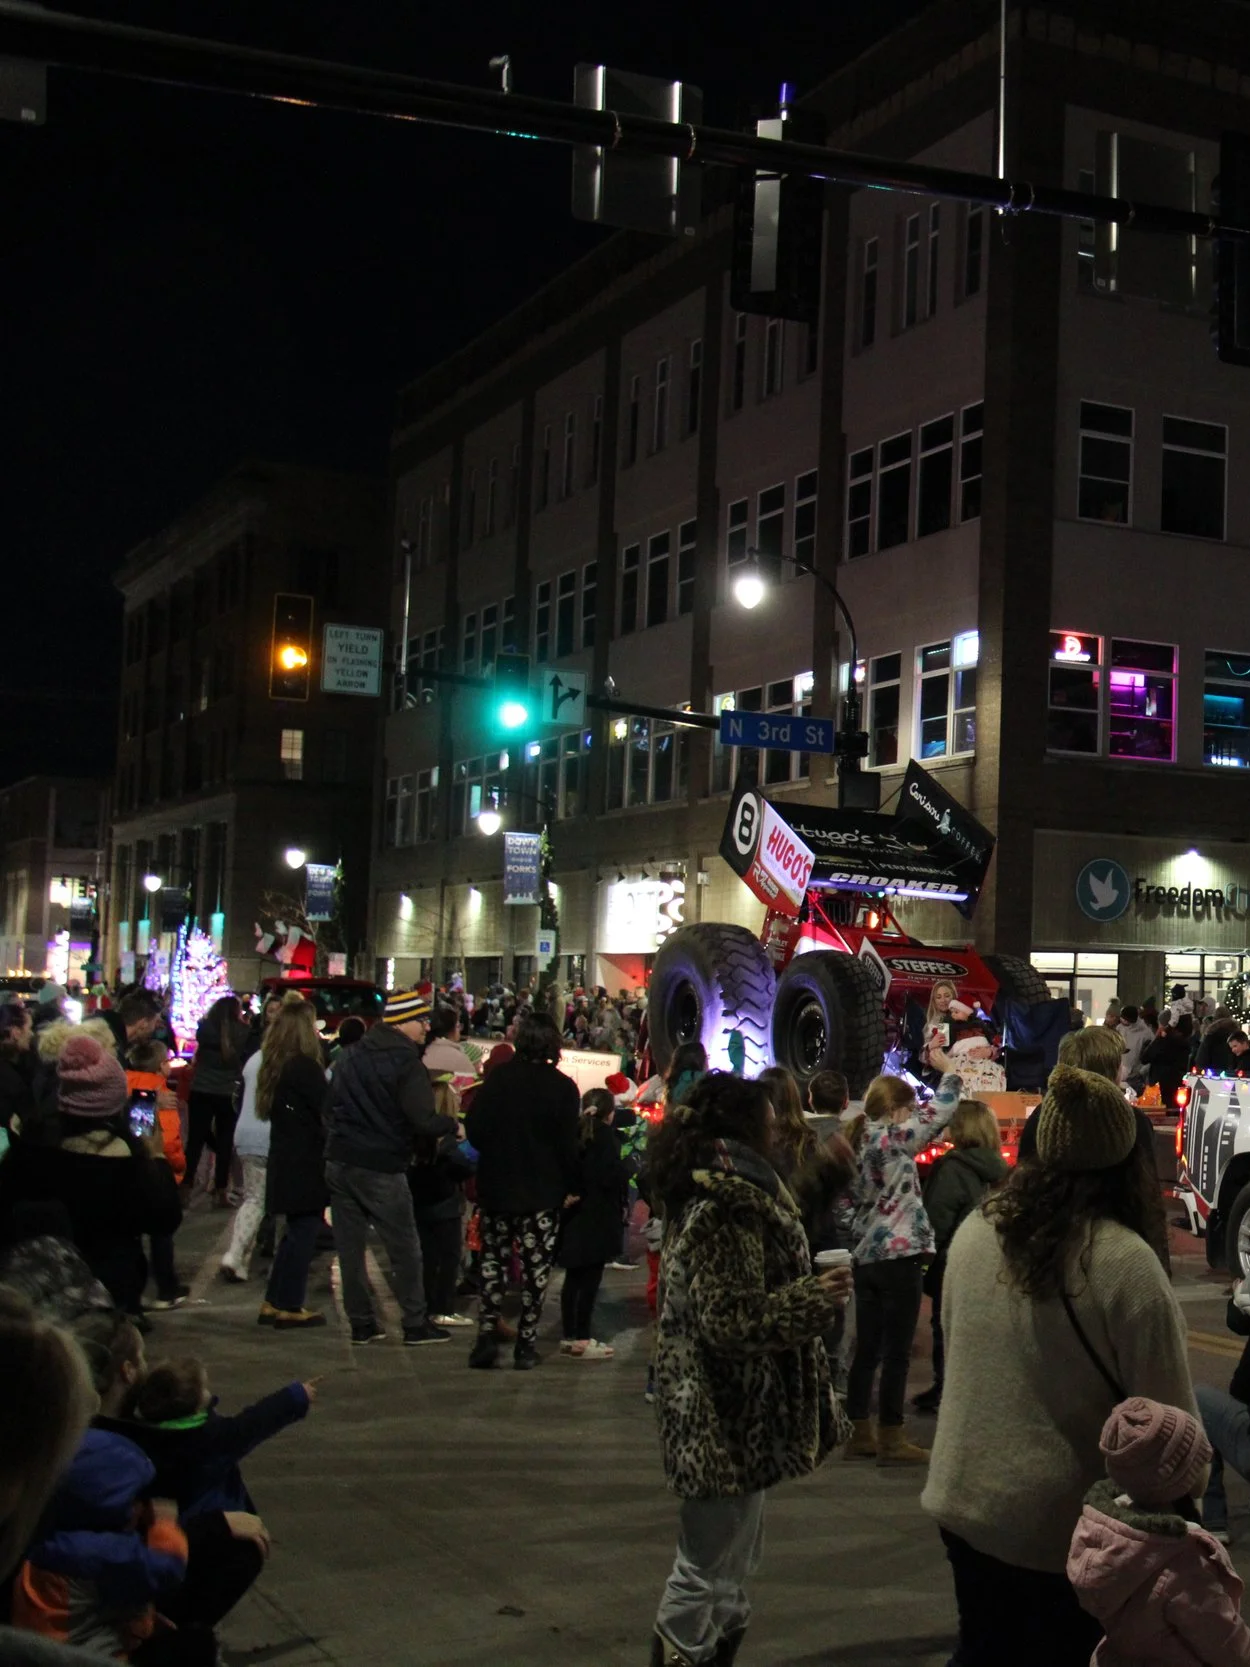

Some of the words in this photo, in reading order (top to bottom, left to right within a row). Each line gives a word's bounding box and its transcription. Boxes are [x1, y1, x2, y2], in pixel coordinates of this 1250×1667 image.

[329, 629, 349, 639] LEFT
[355, 632, 378, 642] TURN
[338, 643, 369, 655] YIELD
[336, 668, 369, 678] YELLOW
[336, 679, 366, 689] ARROW
[729, 718, 743, 738] N
[758, 721, 792, 743] 3rd
[804, 725, 825, 746] St
[738, 801, 755, 846] 8
[507, 836, 537, 847] DOWN
[508, 847, 537, 855] TOWN
[766, 825, 812, 889] HUGO'S
[506, 864, 537, 874] FORKS
[829, 872, 959, 895] CROAKER
[1134, 876, 1224, 909] Freedom
[893, 958, 957, 976] STEFFES
[571, 1054, 612, 1068] Services
